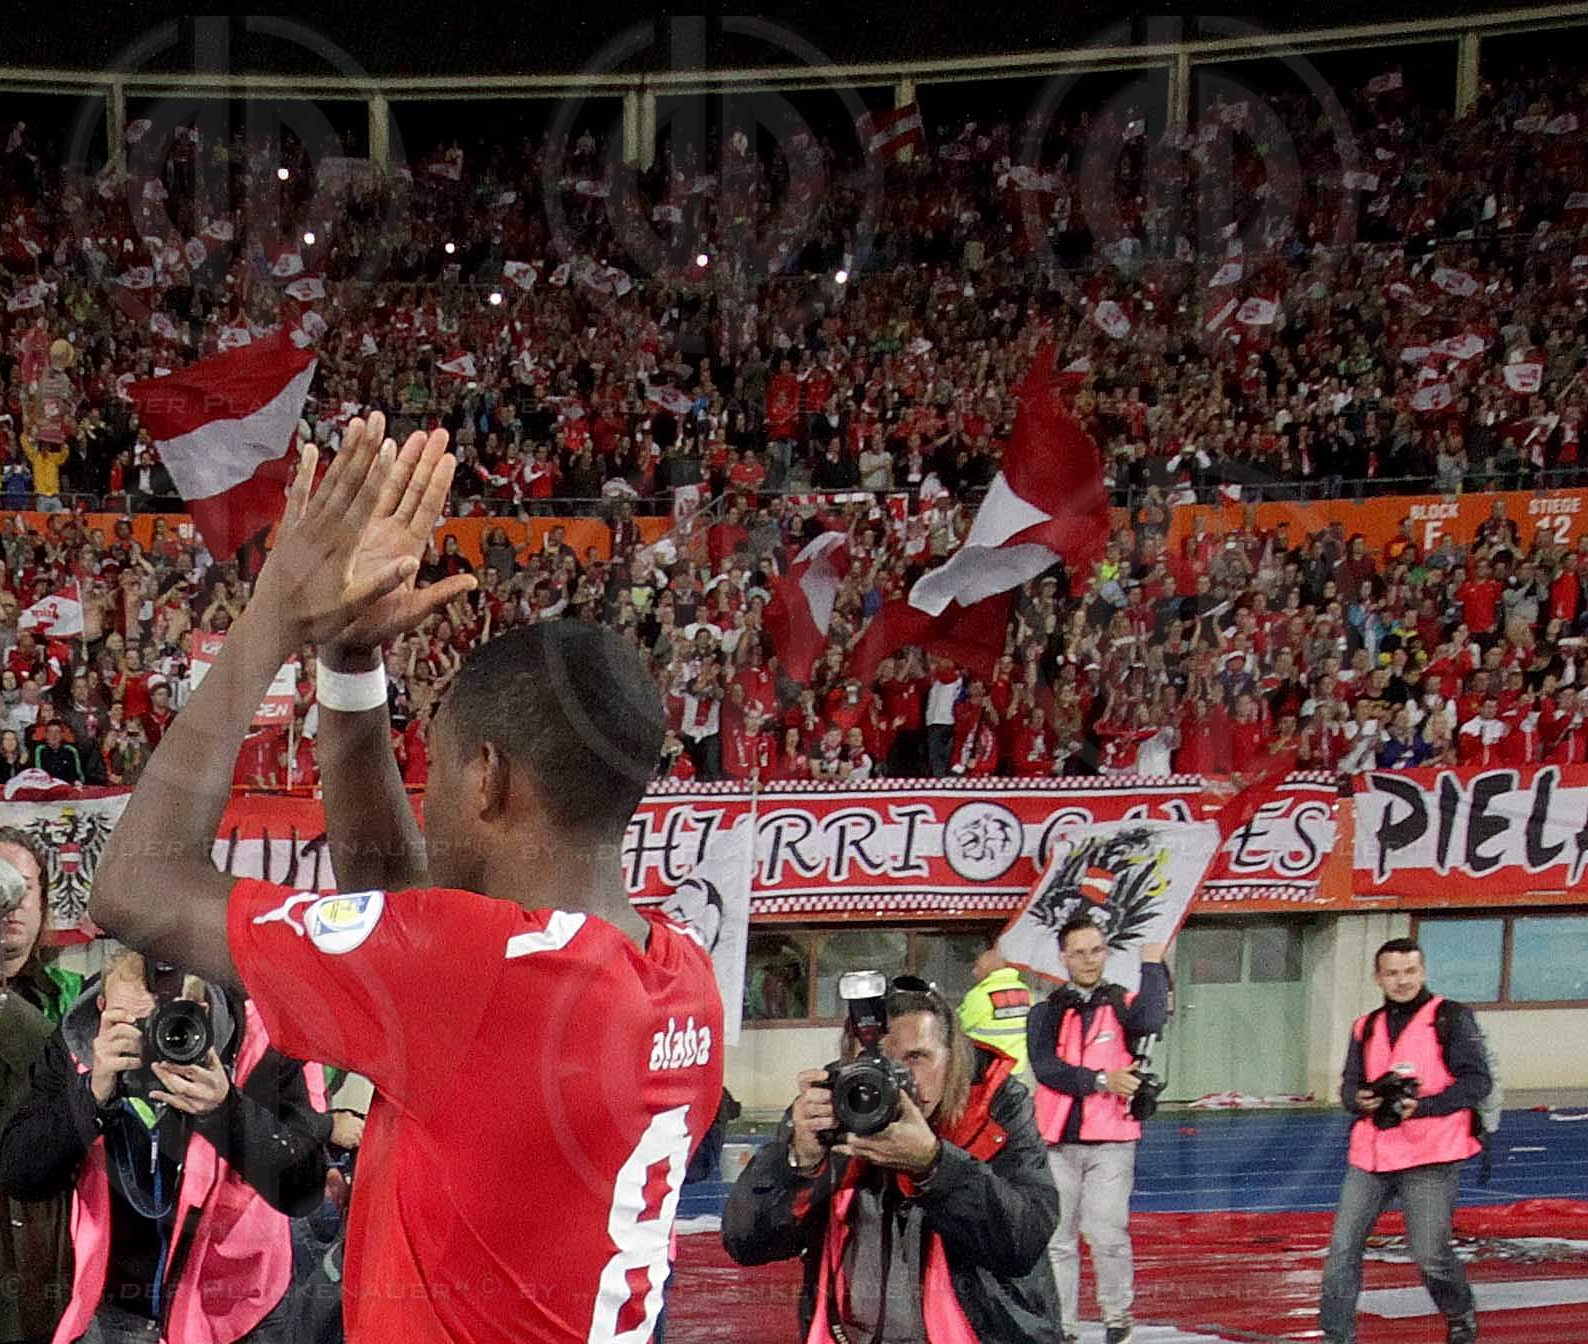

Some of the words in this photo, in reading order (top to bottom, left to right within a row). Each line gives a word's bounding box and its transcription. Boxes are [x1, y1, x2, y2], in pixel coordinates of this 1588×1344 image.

[1410, 503, 1460, 521] BLOCK
[1528, 497, 1581, 515] STIEGE
[1039, 801, 1329, 873] CES
[649, 1017, 711, 1071] alaba
